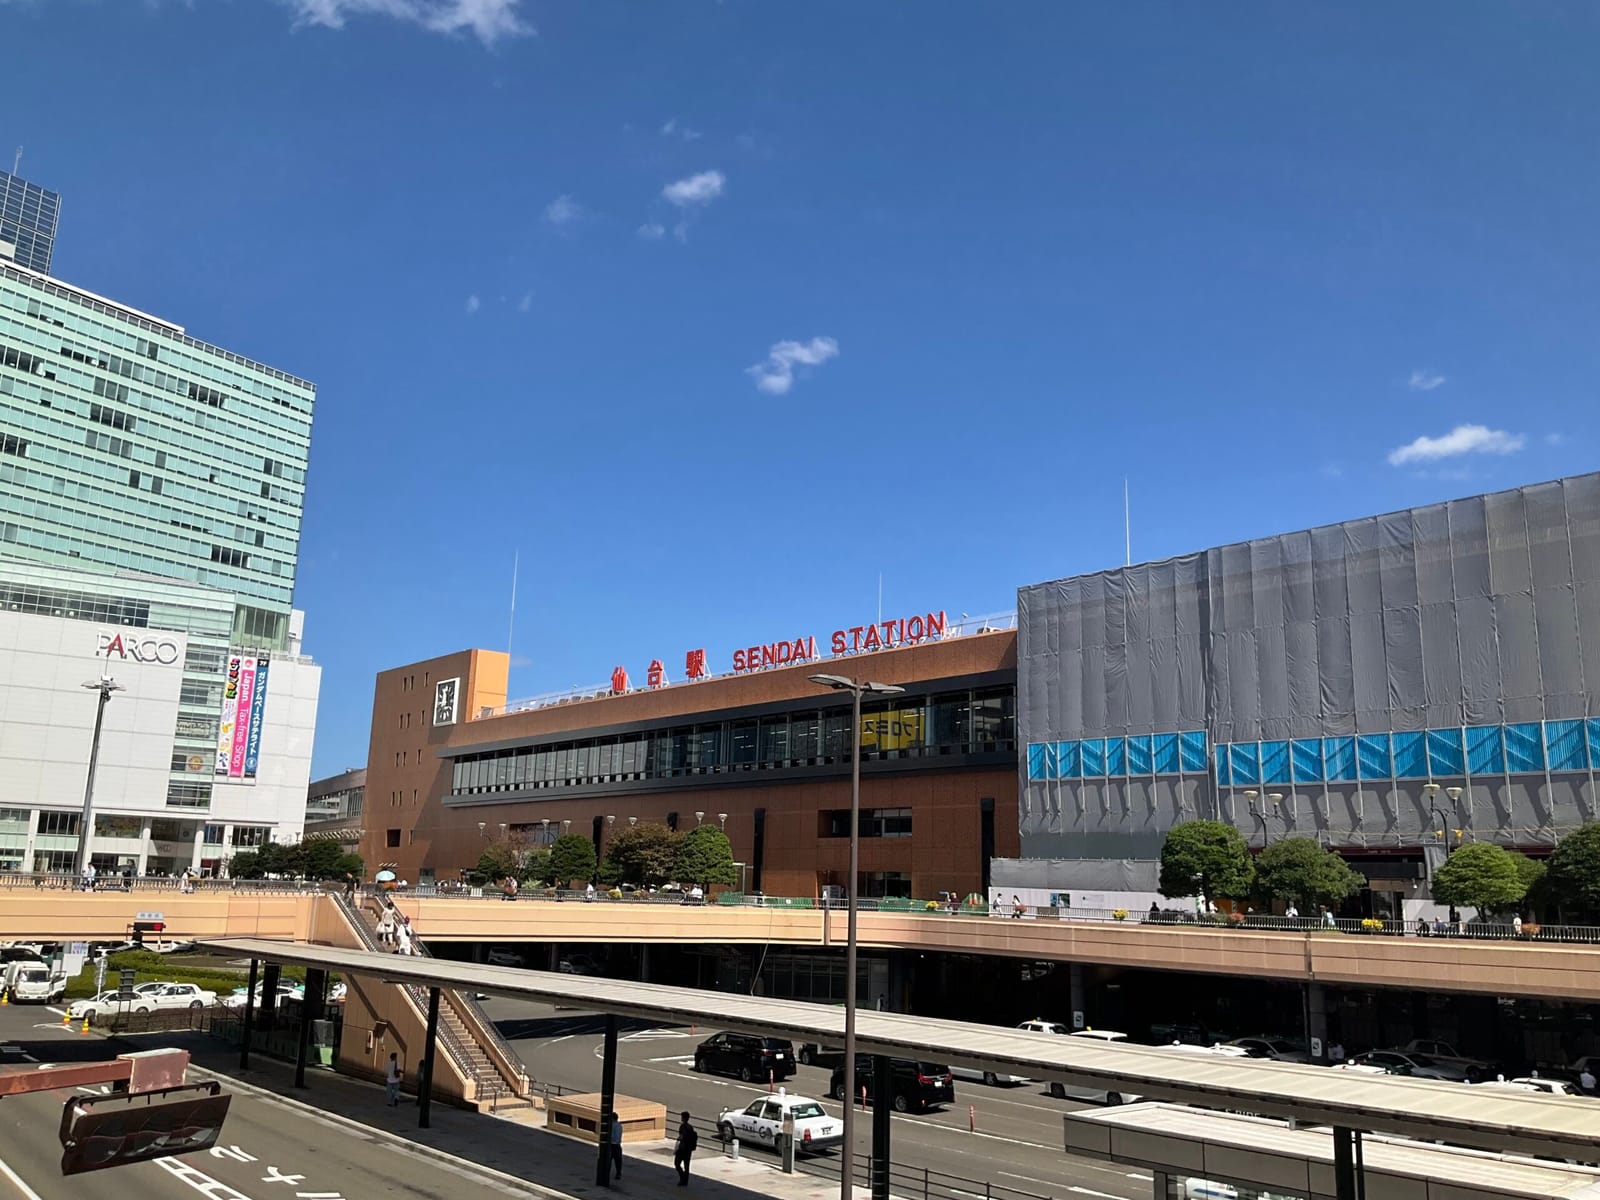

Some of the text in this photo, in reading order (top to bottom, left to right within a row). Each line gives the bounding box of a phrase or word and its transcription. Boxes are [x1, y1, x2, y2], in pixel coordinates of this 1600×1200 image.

[96, 631, 178, 664] PARCO
[733, 611, 945, 671] SENDAI STATION
[611, 648, 705, 691] 仙台駅
[236, 707, 249, 743] Tax-free
[250, 671, 266, 756] ガンダムベースサテライト
[231, 745, 245, 768] Shop
